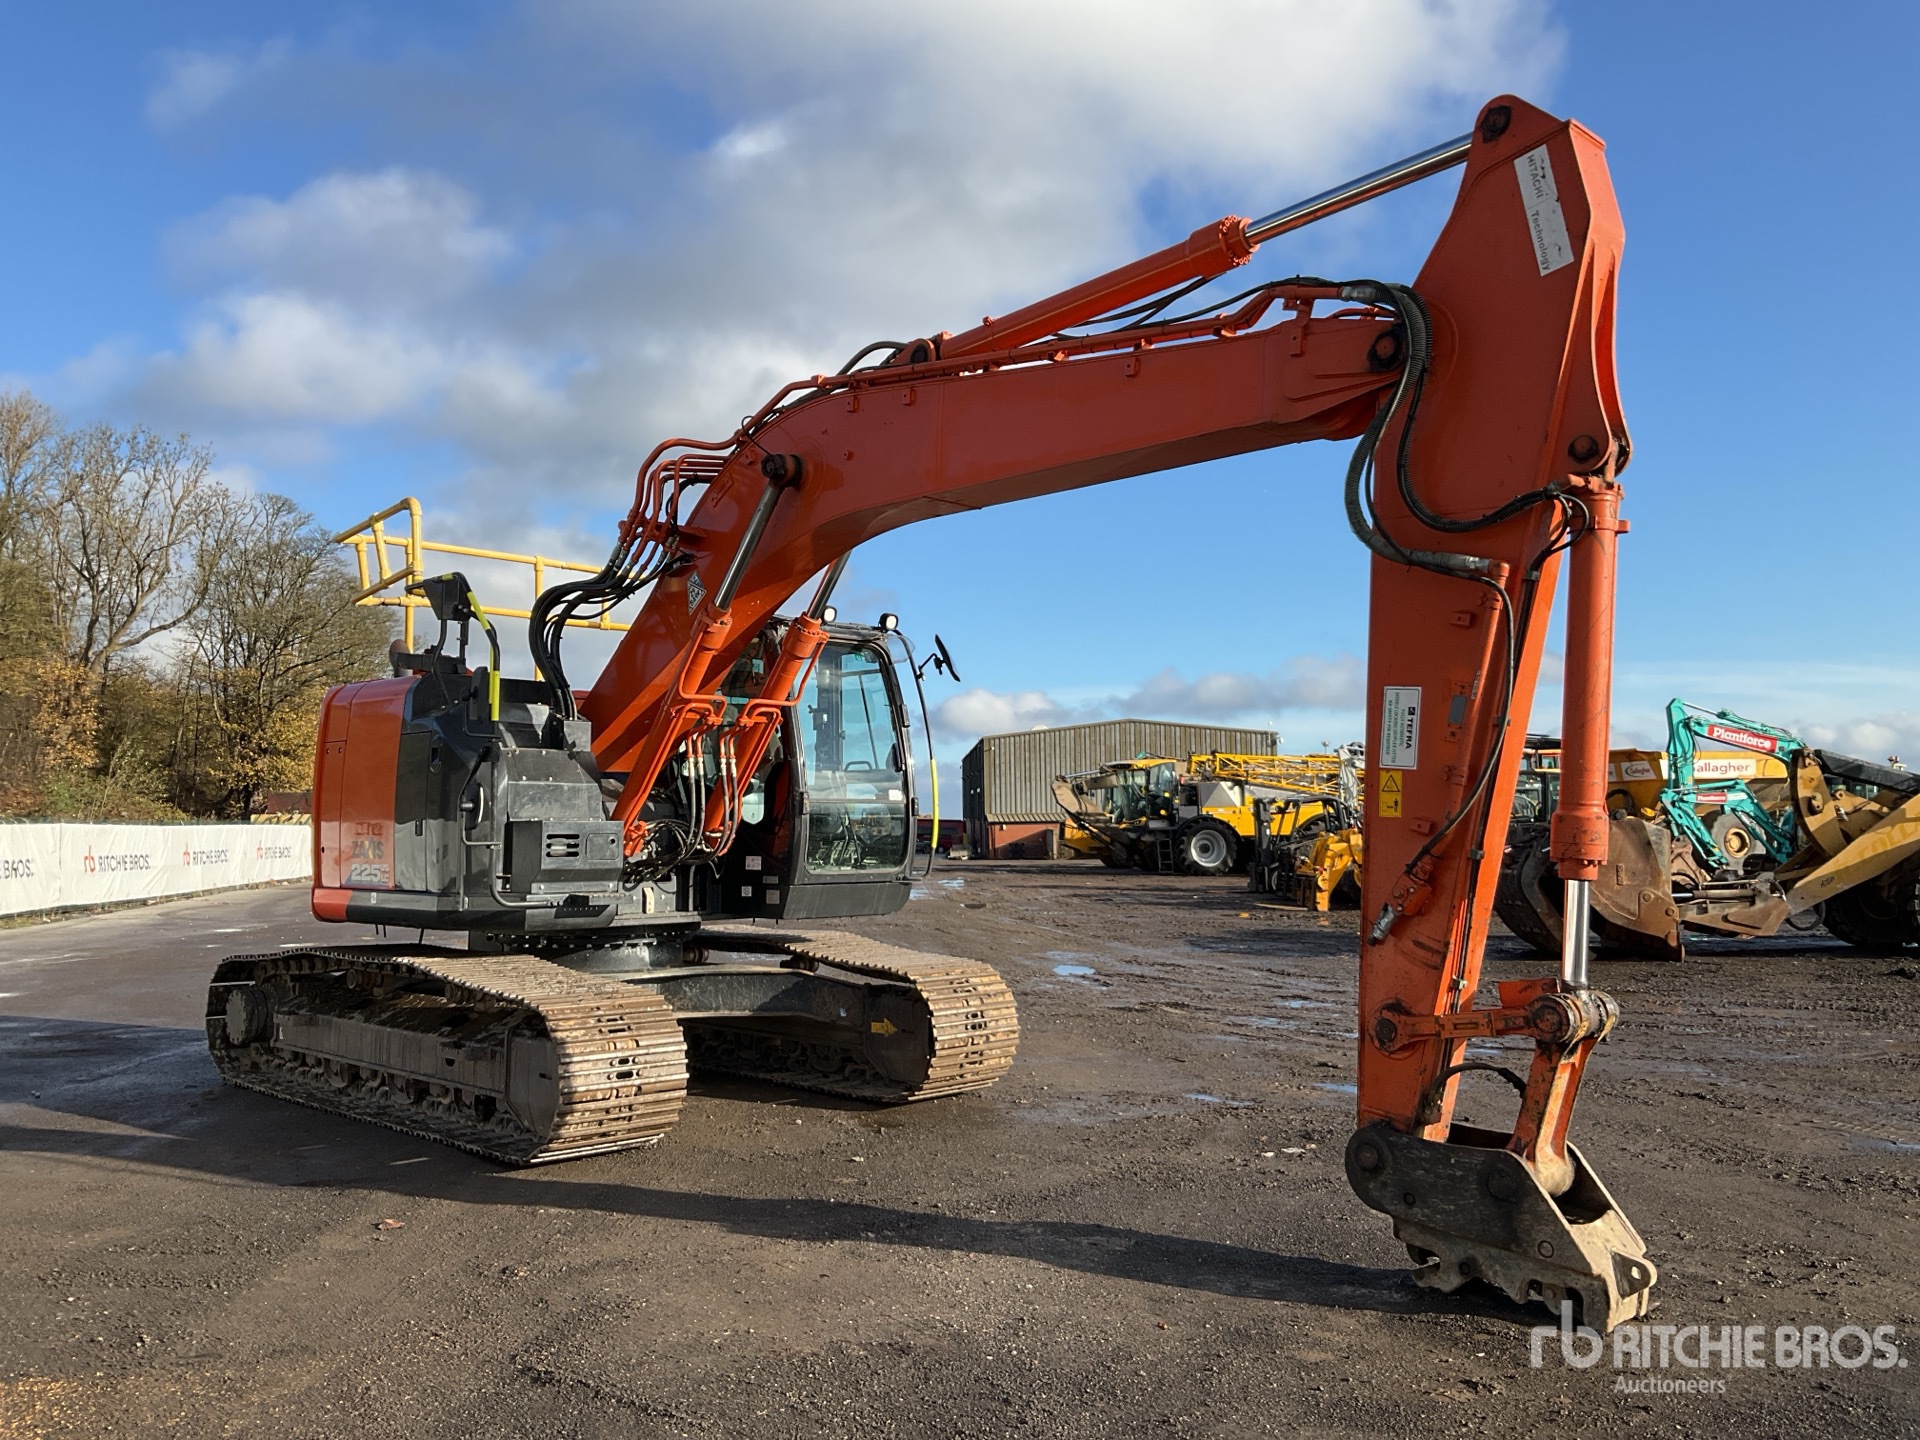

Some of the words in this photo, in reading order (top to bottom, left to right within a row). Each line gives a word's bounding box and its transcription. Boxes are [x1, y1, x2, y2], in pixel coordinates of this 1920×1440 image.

[1527, 154, 1544, 199] HITACHI
[1531, 210, 1551, 271] Technology
[1405, 717, 1414, 749] TEFRA
[1713, 727, 1772, 749] Plantforce
[1693, 762, 1750, 775] allagher
[98, 855, 128, 872] RITCHIE
[351, 863, 381, 883] 225
[381, 864, 390, 872] US
